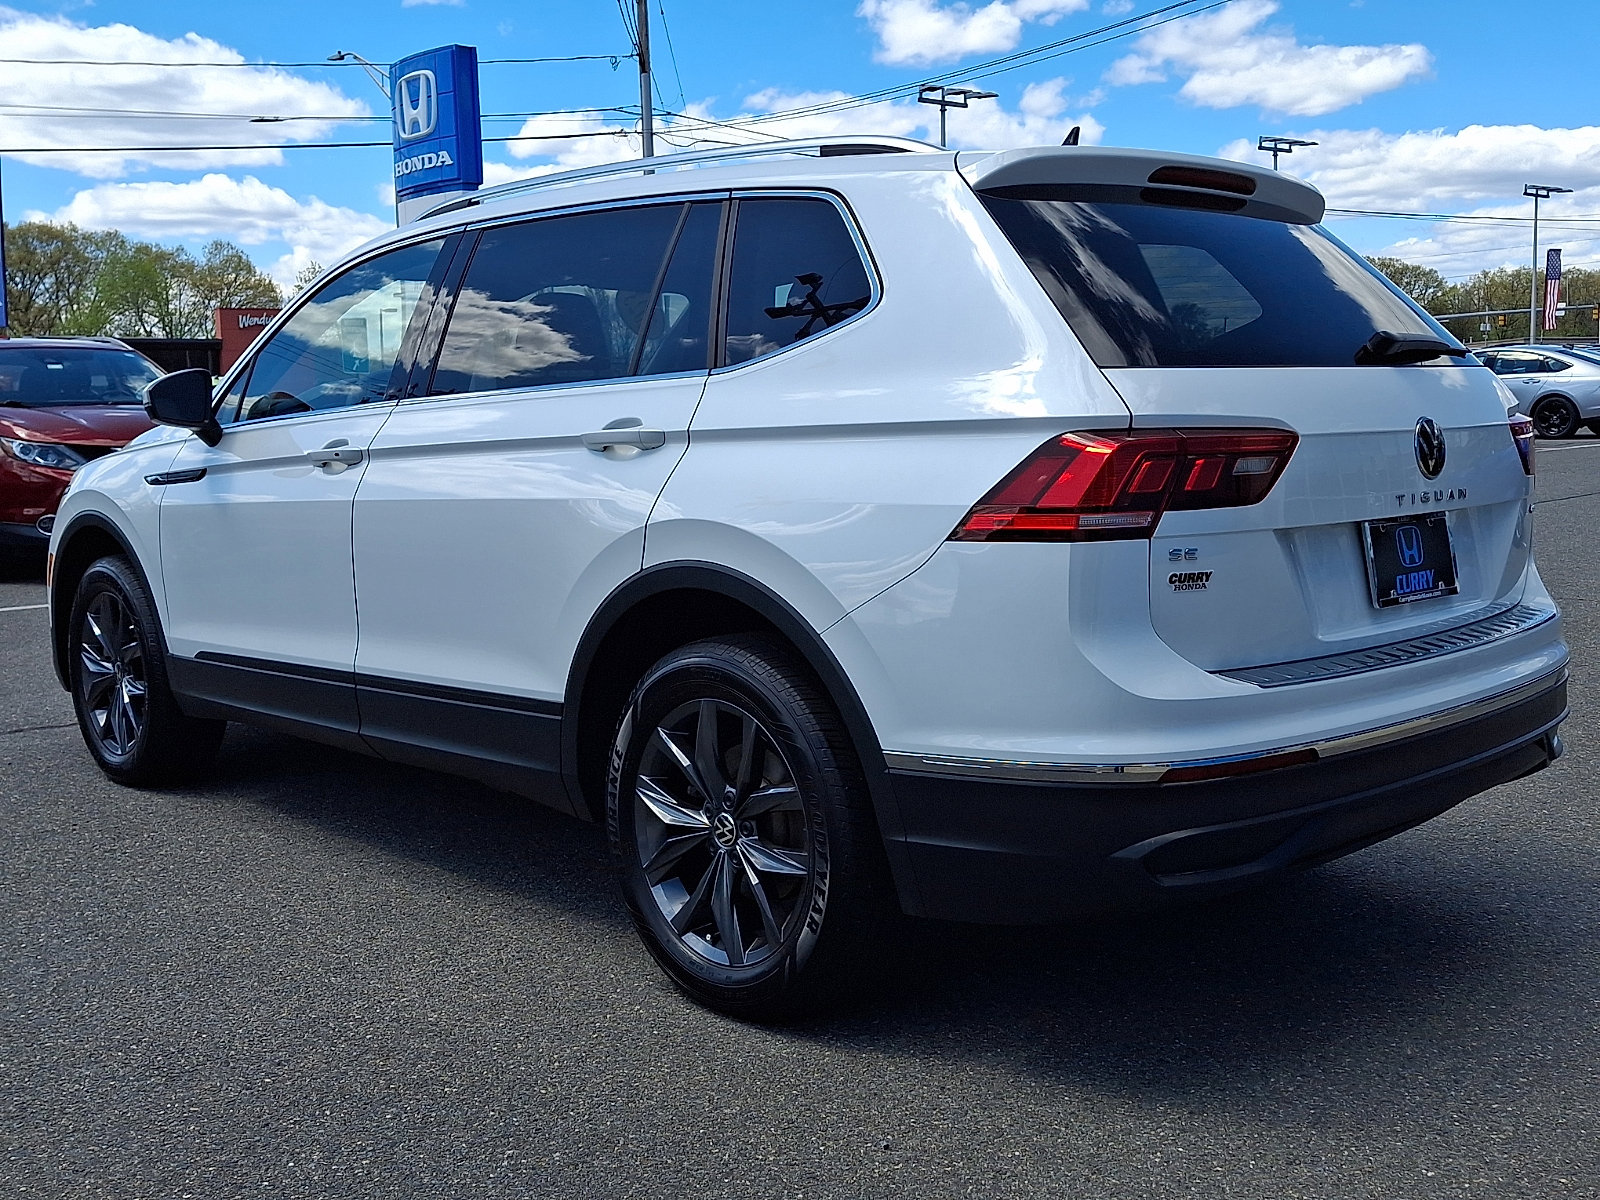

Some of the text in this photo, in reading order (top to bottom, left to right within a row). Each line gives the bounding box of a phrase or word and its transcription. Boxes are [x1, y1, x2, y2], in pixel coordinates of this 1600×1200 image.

[395, 151, 453, 177] HONDA
[1395, 488, 1468, 508] TIGUAN
[1168, 548, 1198, 561] SE
[1168, 571, 1213, 585] CURRY
[1396, 569, 1435, 594] CURRY
[1173, 583, 1208, 592] HONDA
